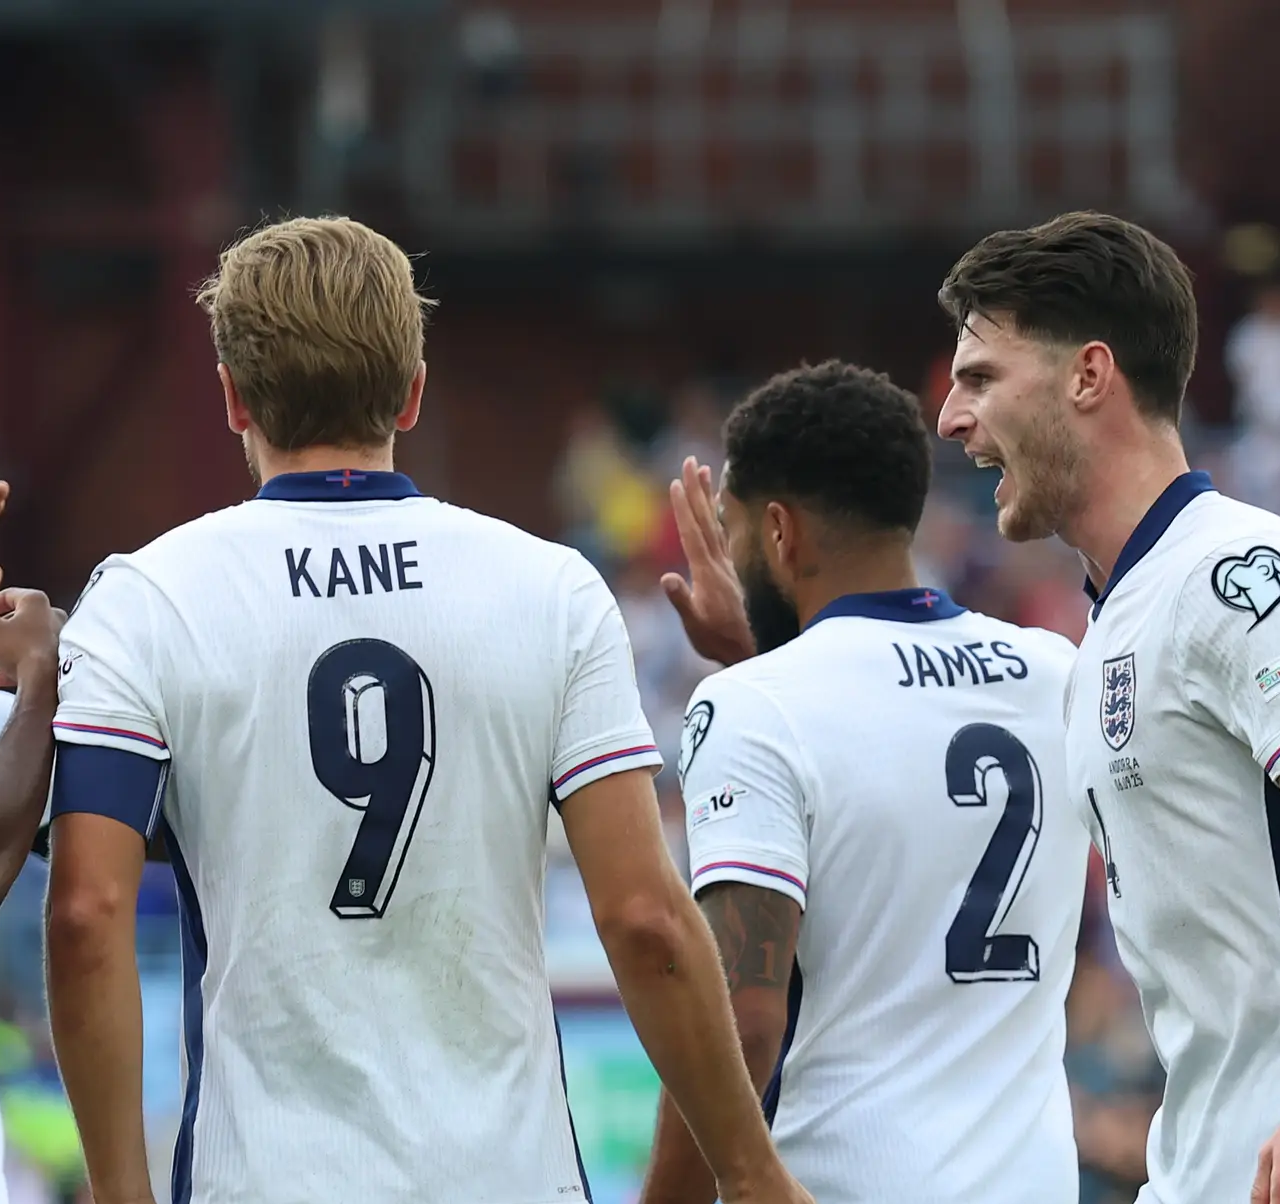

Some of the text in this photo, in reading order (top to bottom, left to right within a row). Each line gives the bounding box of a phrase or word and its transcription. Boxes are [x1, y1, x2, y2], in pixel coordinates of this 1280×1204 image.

[285, 540, 423, 598] KANE
[892, 641, 1028, 687] JAMES
[307, 637, 437, 919] 9
[945, 722, 1043, 983] 2
